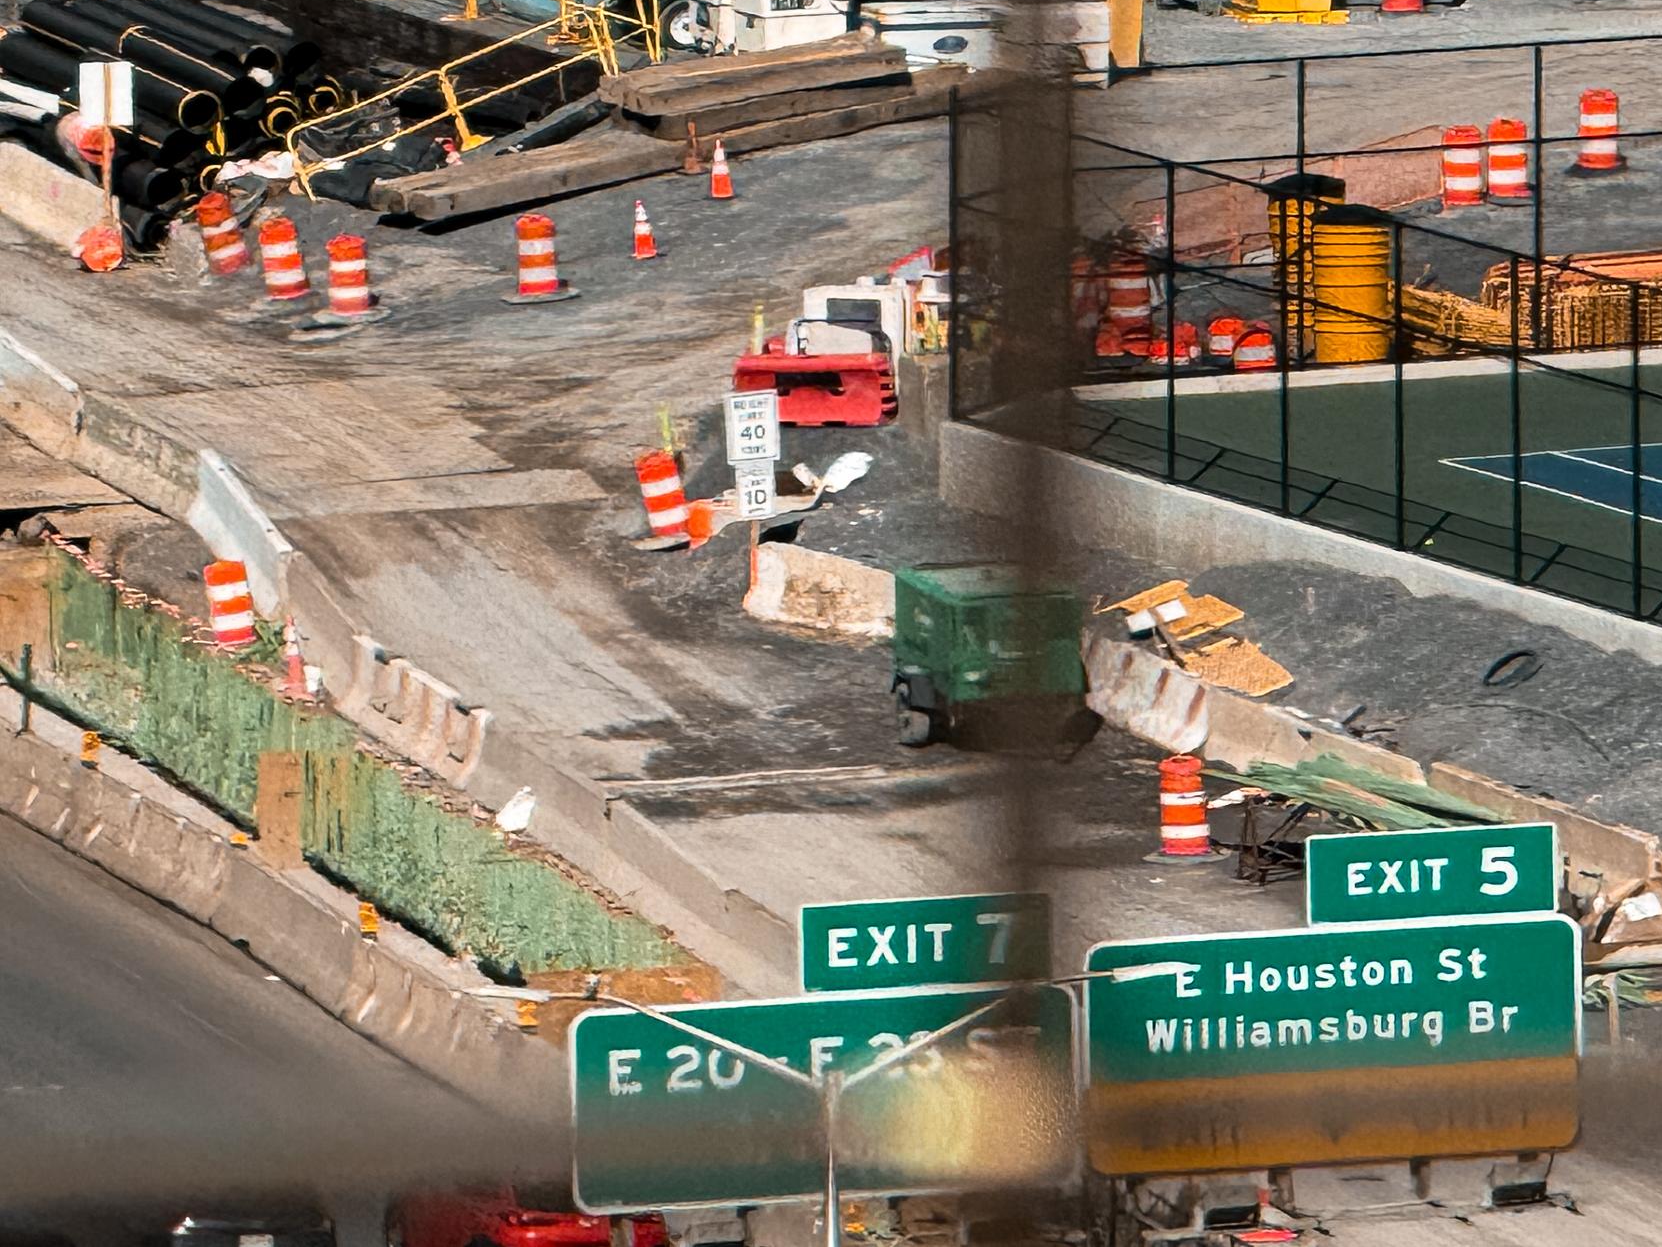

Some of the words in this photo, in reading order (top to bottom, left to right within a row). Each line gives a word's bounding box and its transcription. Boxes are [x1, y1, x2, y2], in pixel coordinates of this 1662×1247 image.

[740, 424, 766, 441] 40
[1347, 858, 1449, 896] EXIT
[1480, 846, 1519, 896] 5
[828, 923, 953, 967] EXIT
[976, 912, 1018, 964] 7
[1176, 964, 1202, 998] E
[1225, 955, 1413, 995] Houston
[1437, 947, 1488, 982] St
[1145, 1008, 1444, 1053] Williamsburg
[1468, 1000, 1520, 1034] Br
[608, 1049, 643, 1097] E
